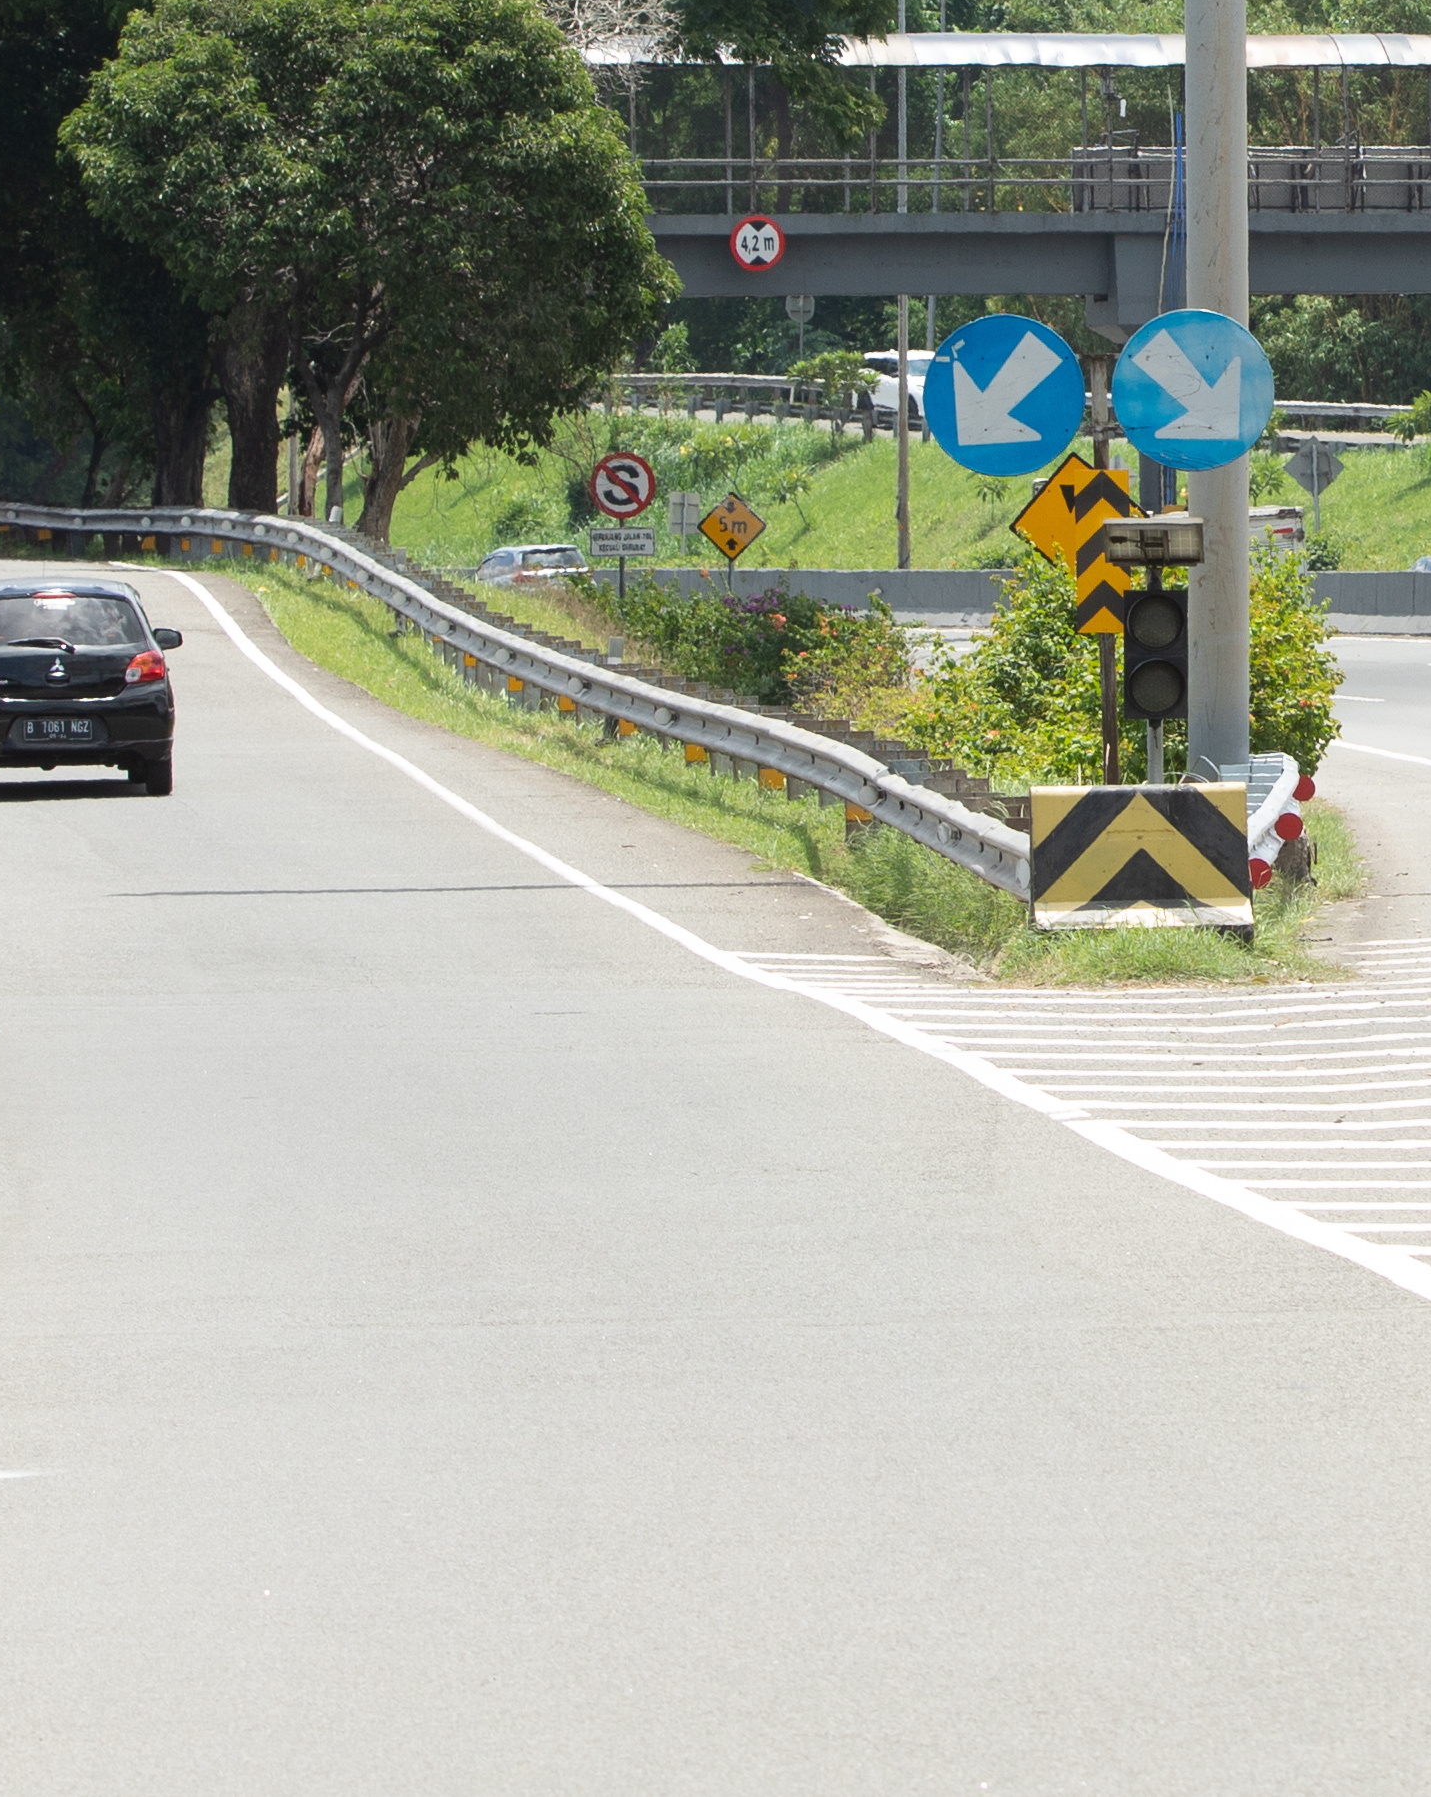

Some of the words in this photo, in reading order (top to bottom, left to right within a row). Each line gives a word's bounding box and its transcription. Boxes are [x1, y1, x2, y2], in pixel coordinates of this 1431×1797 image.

[740, 234, 760, 255] 4,2
[26, 720, 34, 734] B
[41, 720, 66, 733] 1061
[70, 719, 90, 733] NGZ
